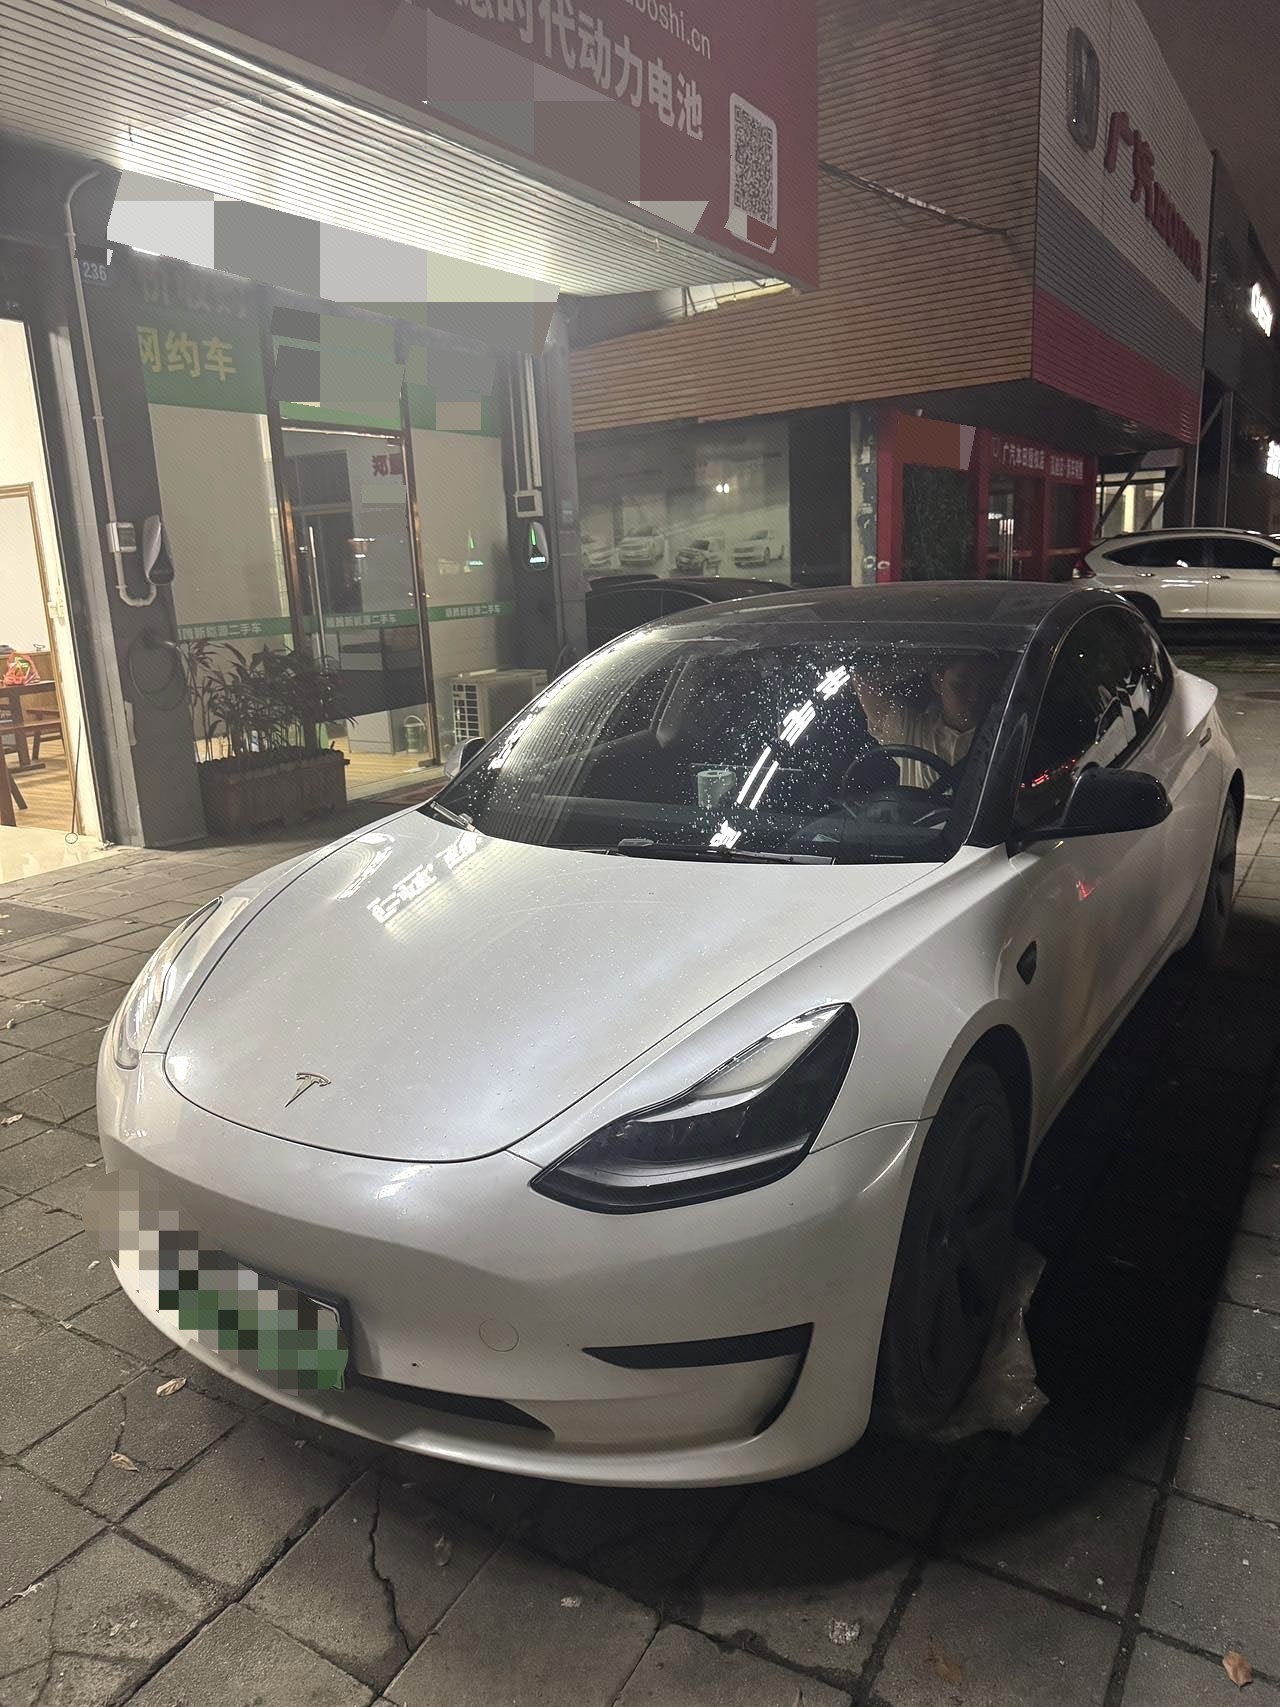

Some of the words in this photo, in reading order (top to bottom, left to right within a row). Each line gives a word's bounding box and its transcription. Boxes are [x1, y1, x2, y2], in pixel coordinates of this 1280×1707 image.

[455, 0, 704, 141] 时代动力电池
[82, 261, 108, 281] 236
[136, 325, 237, 382] 网约车
